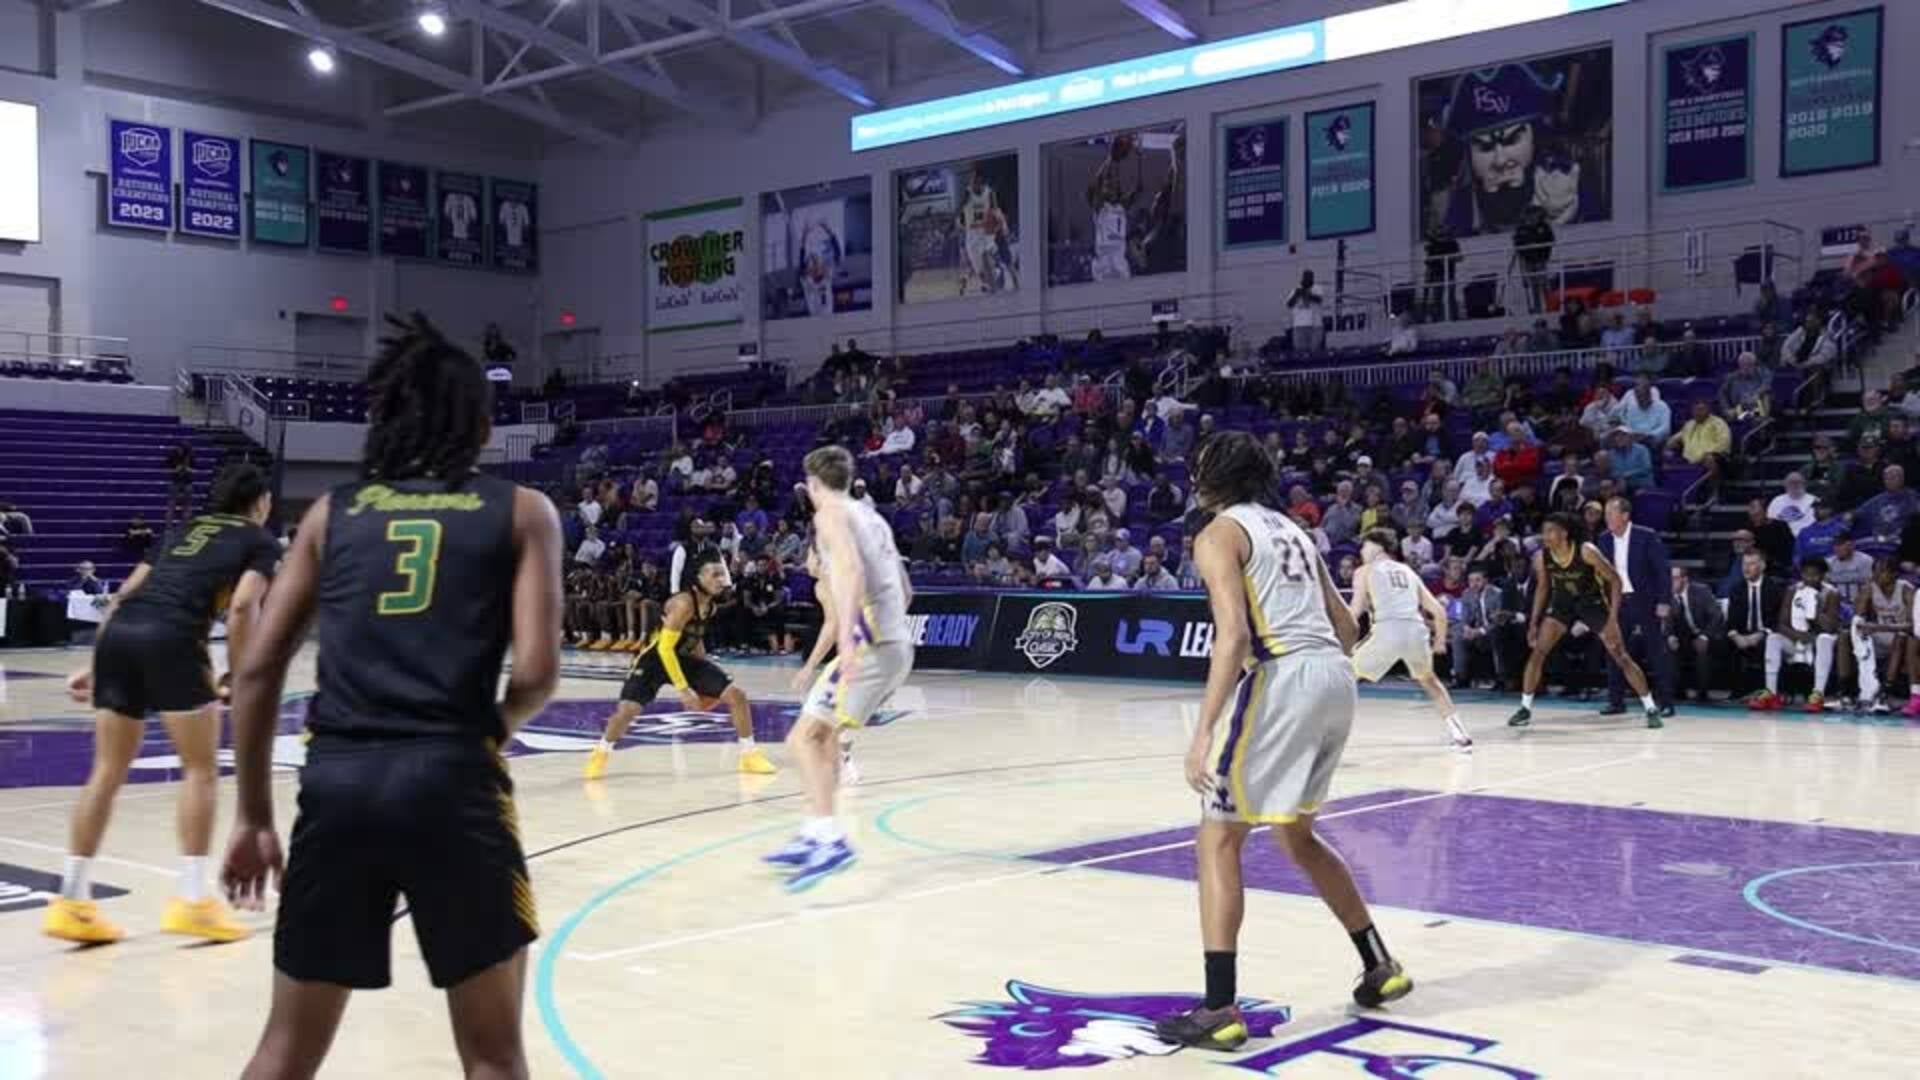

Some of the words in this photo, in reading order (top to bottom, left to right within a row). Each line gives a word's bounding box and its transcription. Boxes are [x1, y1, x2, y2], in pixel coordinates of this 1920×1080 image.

[119, 203, 164, 220] 2023
[191, 212, 234, 229] 2022
[171, 525, 223, 555] 5
[377, 519, 442, 614] 3
[1272, 535, 1316, 583] 21
